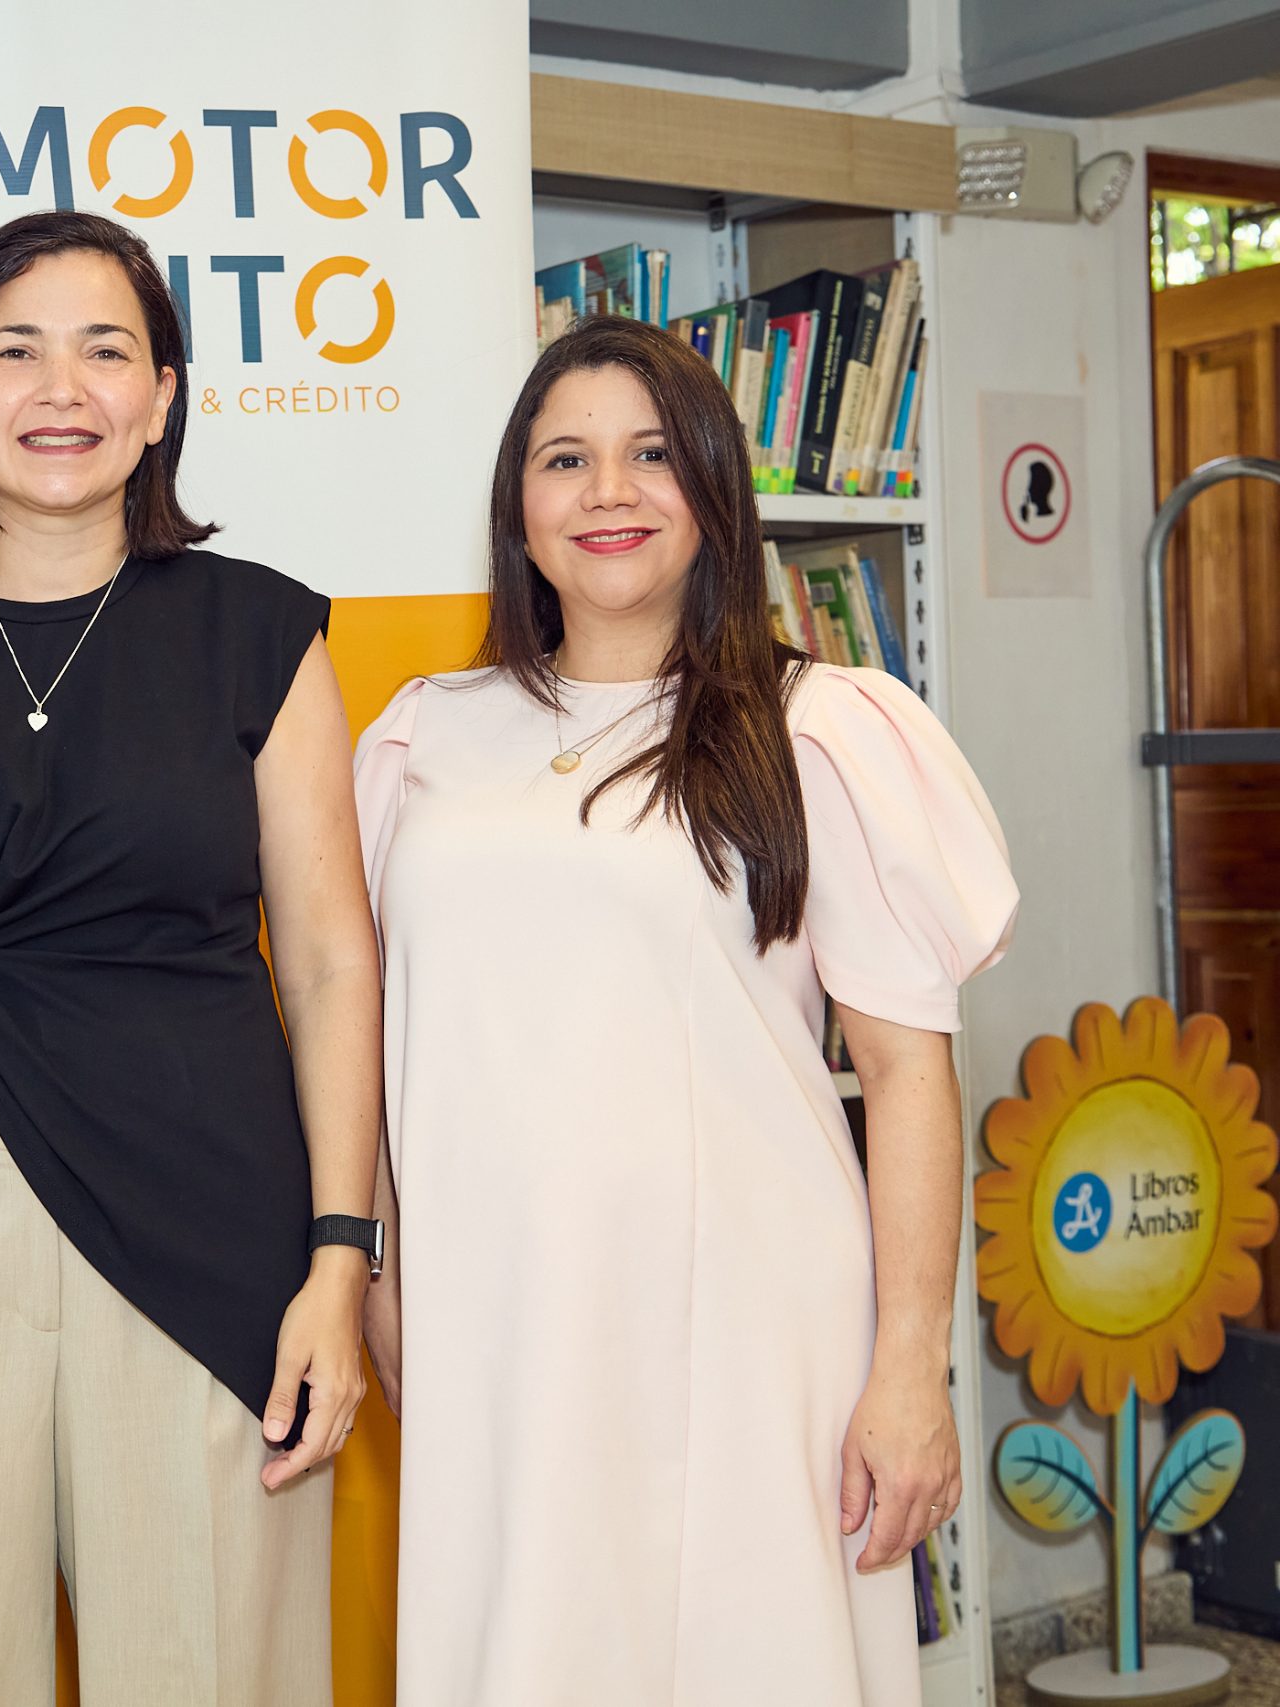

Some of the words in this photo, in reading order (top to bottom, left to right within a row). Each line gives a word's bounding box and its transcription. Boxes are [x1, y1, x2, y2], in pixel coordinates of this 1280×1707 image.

[201, 388, 222, 414] &
[239, 380, 401, 414] CRÉDITO
[1130, 1171, 1200, 1200] Libros
